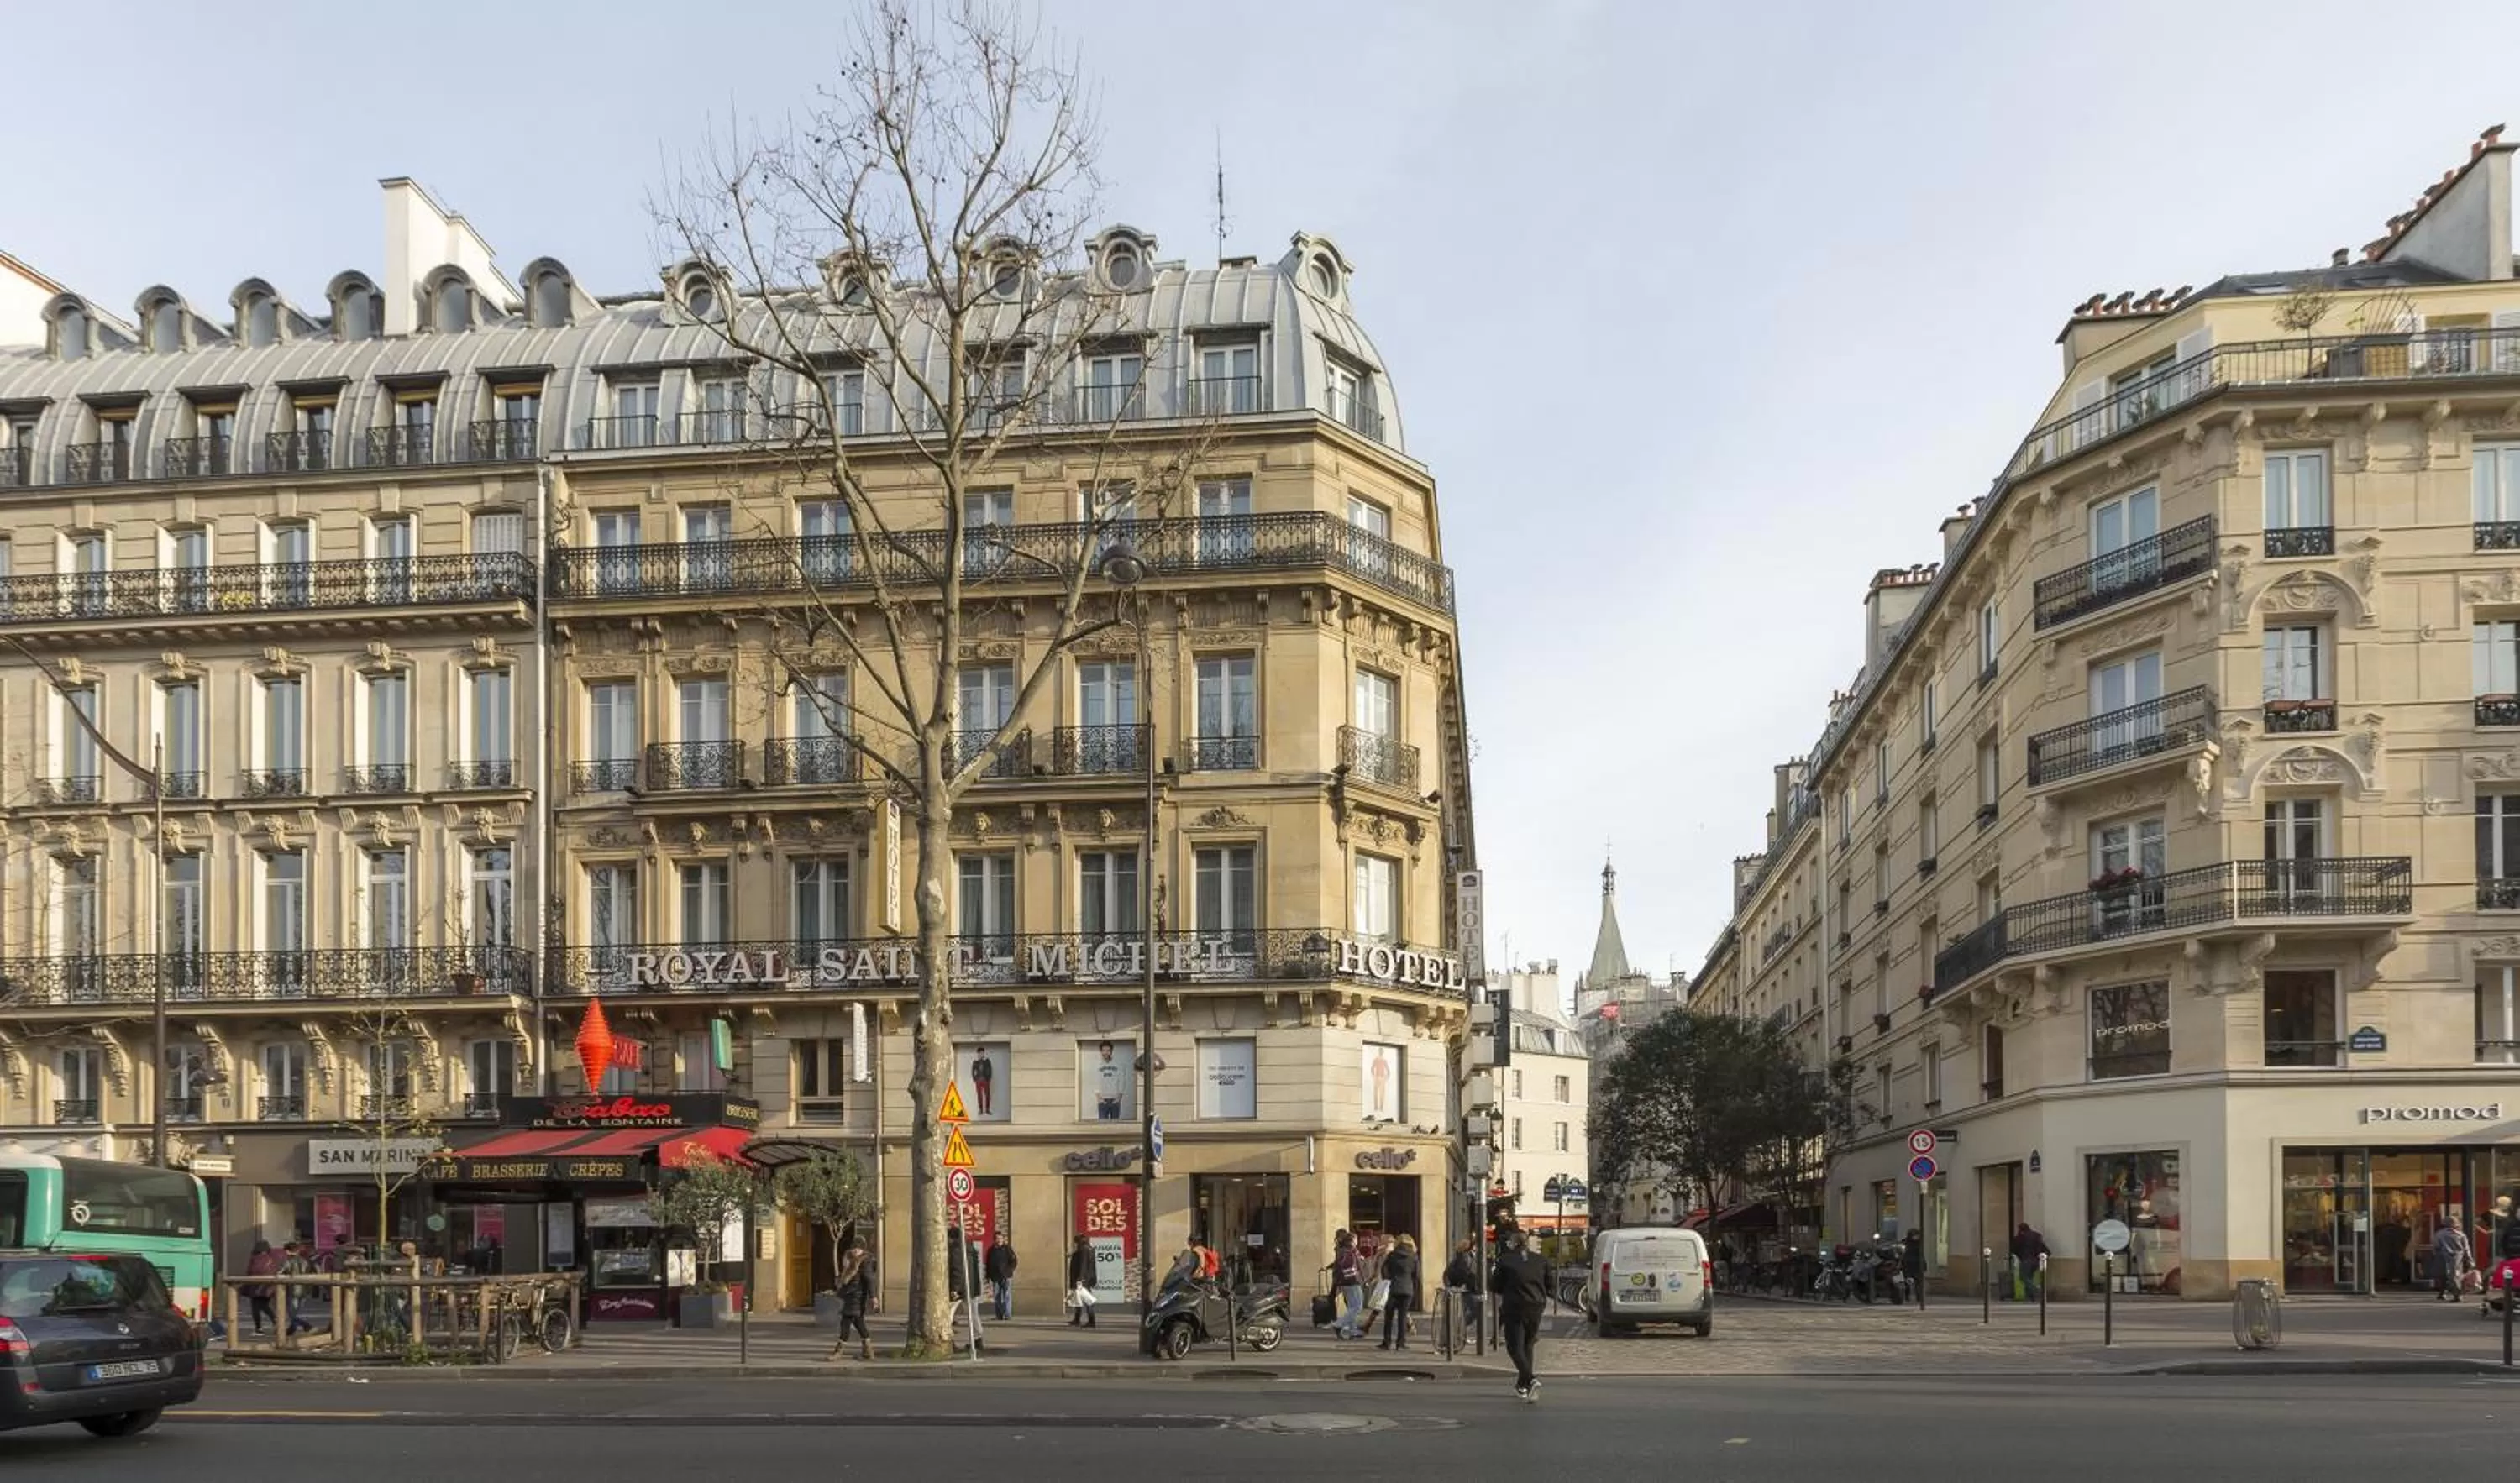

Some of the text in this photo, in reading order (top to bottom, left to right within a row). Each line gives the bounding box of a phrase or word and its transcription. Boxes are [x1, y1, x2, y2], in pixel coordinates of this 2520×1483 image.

[888, 825, 898, 928] HOTEL
[629, 949, 789, 985] ROYAL
[1027, 940, 1235, 977] MICHEL
[1338, 939, 1466, 991] HOTEL
[533, 1118, 554, 1126] DE
[567, 1118, 589, 1126] LA
[2367, 1103, 2502, 1124] promod
[1916, 1137, 1929, 1147] 15
[319, 1149, 426, 1163] SAN MRIN
[472, 1163, 548, 1179] BRASSERIE
[570, 1161, 623, 1177] CRÊPES
[954, 1177, 968, 1191] 30
[1086, 1198, 1128, 1215] SOL
[1087, 1215, 1126, 1232] DES
